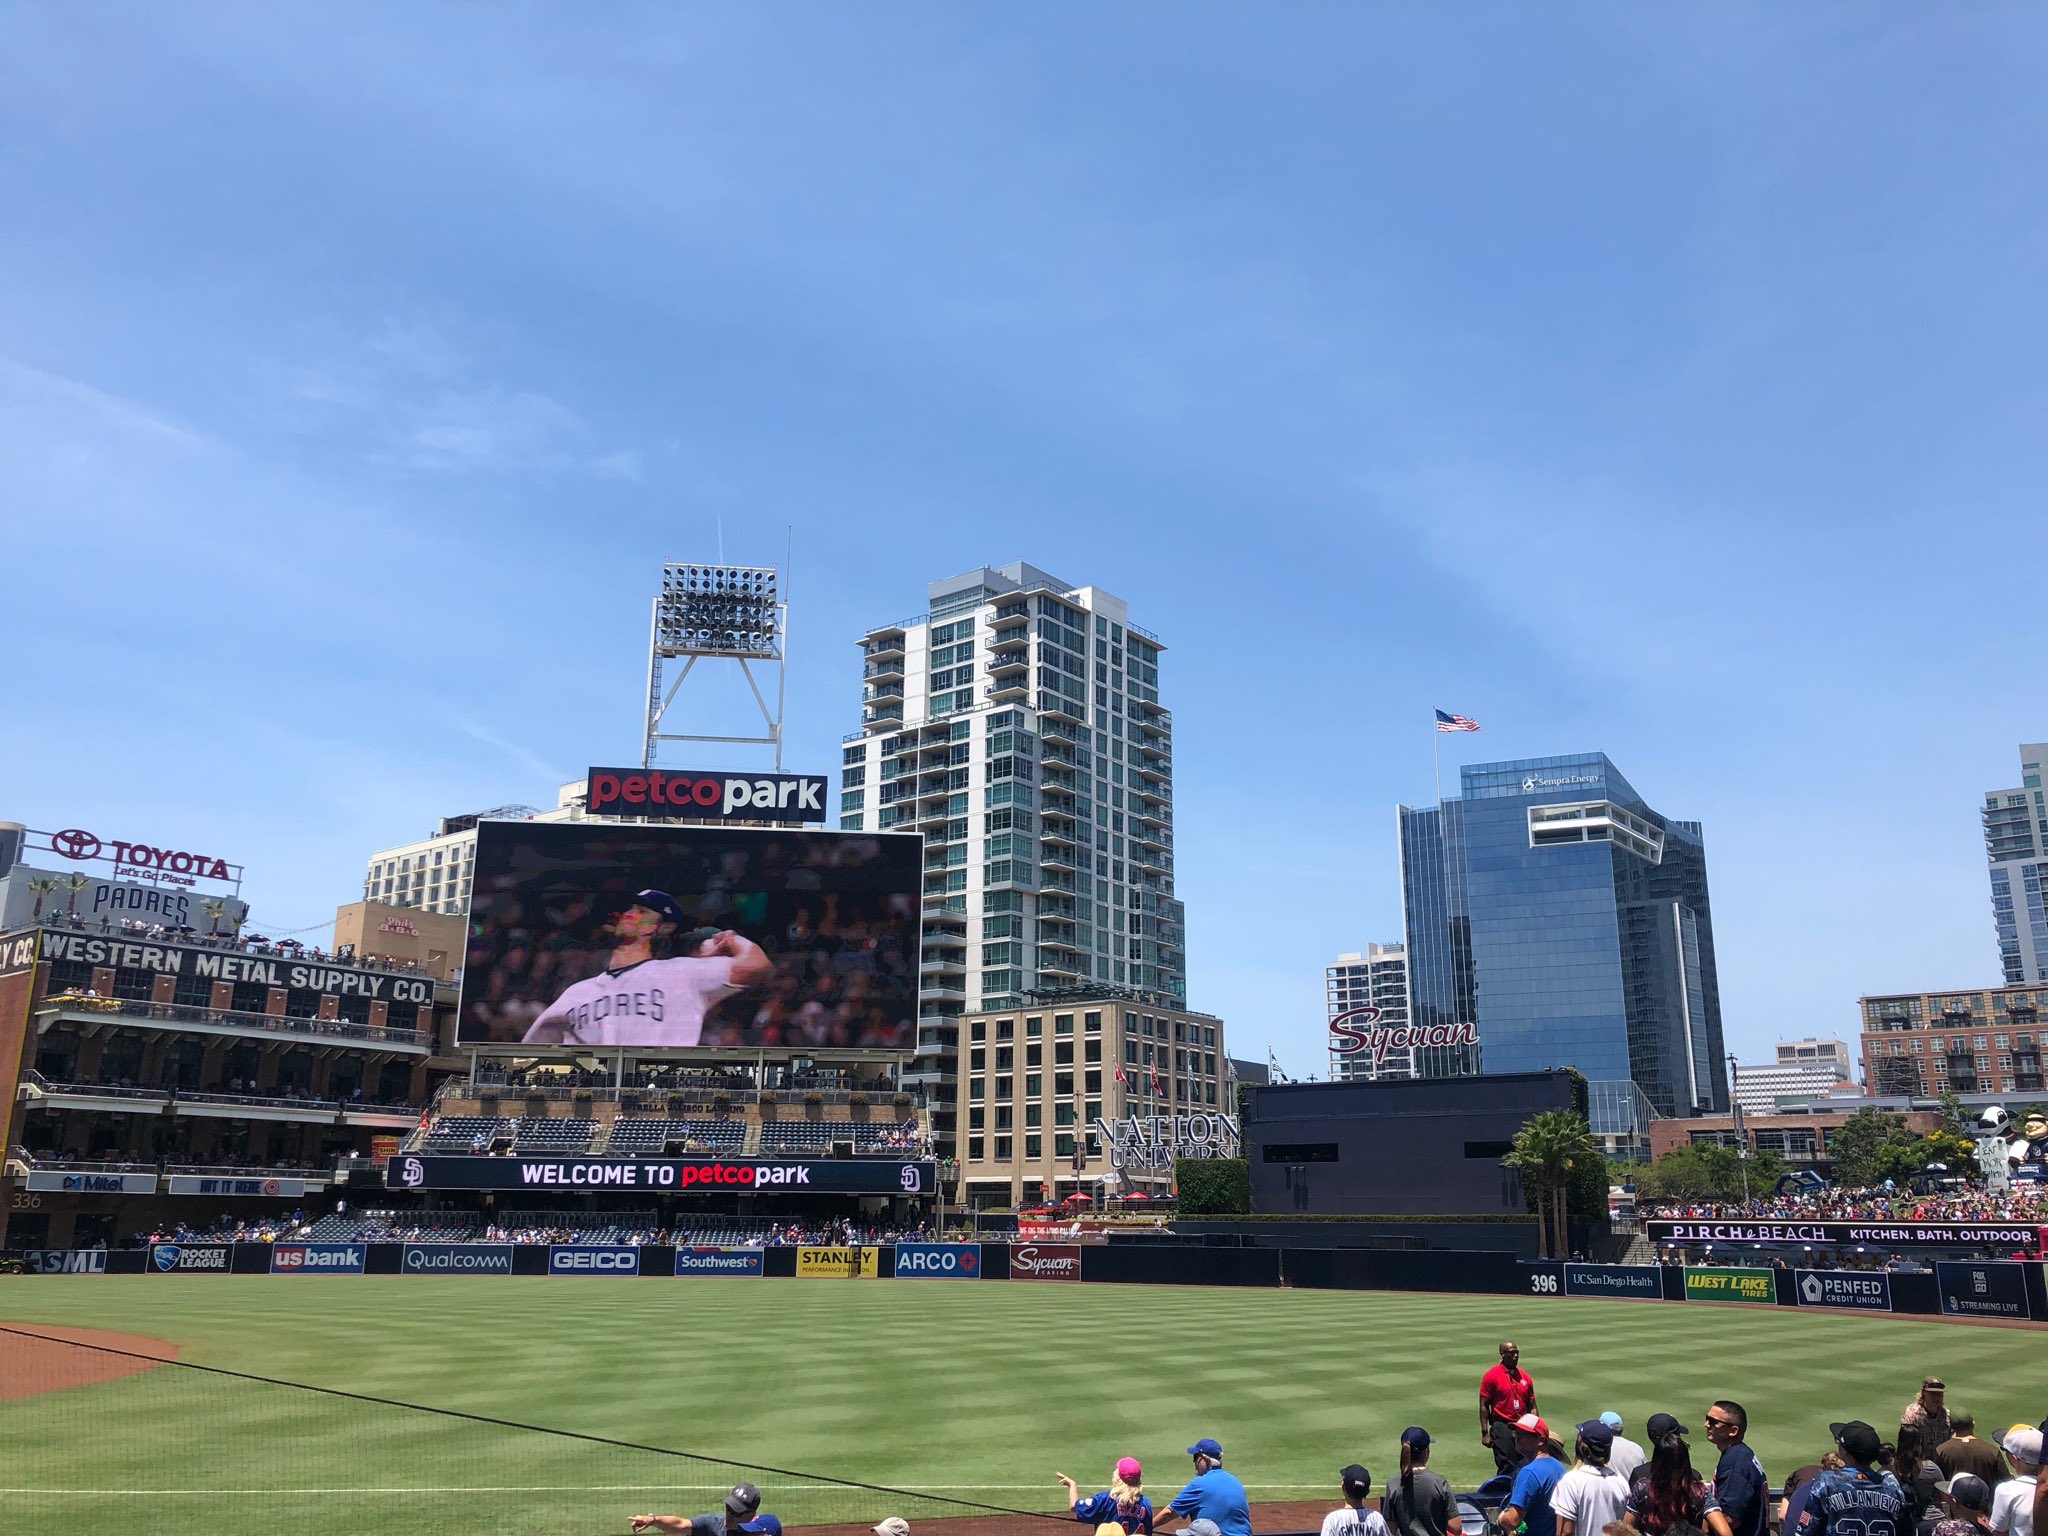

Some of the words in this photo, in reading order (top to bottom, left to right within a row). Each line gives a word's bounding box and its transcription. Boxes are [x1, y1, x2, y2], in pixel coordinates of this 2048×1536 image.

[1538, 777, 1570, 787] Sempra
[1571, 775, 1599, 784] Energy
[112, 840, 229, 880] TOYOTA
[142, 870, 159, 881] Go
[161, 873, 197, 887] Places
[93, 884, 190, 925] PADRES
[13, 936, 35, 967] CO.
[43, 933, 183, 973] WESTERN
[196, 953, 282, 986] METAL
[290, 966, 385, 998] SUPPLY
[393, 979, 431, 1004] CO.
[1328, 1006, 1481, 1064] Sycuan
[1093, 1112, 1240, 1147] NATION
[84, 1175, 124, 1191] Mitel
[522, 1164, 637, 1185] WELCOME
[644, 1165, 674, 1185] TO
[221, 1180, 234, 1194] IT
[235, 1180, 262, 1195] HERE
[11, 1192, 42, 1209] 336
[1673, 1225, 1743, 1239] PIRCH
[1758, 1226, 1826, 1240] BEACH
[1850, 1229, 1914, 1240] KITCHEN.
[1917, 1230, 1957, 1241] BATH.
[1960, 1230, 2037, 1242] OUTDOOR.
[30, 1250, 103, 1273] ASML
[180, 1248, 227, 1259] ROCKET
[407, 1249, 508, 1270] Qualcomm
[553, 1252, 636, 1269] GEICO
[681, 1255, 750, 1269] Southwest
[897, 1251, 956, 1270] ARCO
[1016, 1247, 1074, 1276] Sycuan
[179, 1258, 226, 1268] LEAGUE
[1531, 1274, 1558, 1293] 396
[1573, 1273, 1586, 1284] UC
[1586, 1274, 1602, 1285] San
[1602, 1275, 1626, 1288] Diego
[1626, 1275, 1653, 1287] Health
[1687, 1274, 1729, 1289] WEST
[1730, 1275, 1769, 1291] LAKE
[1972, 1271, 1986, 1281] FOX
[1741, 1289, 1768, 1298] TIRES
[1824, 1279, 1882, 1295] PENFED
[1975, 1283, 1987, 1293] GO
[1826, 1294, 1854, 1303] CREDIT
[1856, 1296, 1882, 1305] UNION
[1960, 1300, 2001, 1311] STREAMING
[2002, 1303, 2019, 1312] LIVE
[1828, 1489, 1901, 1514] VILLANUEVA
